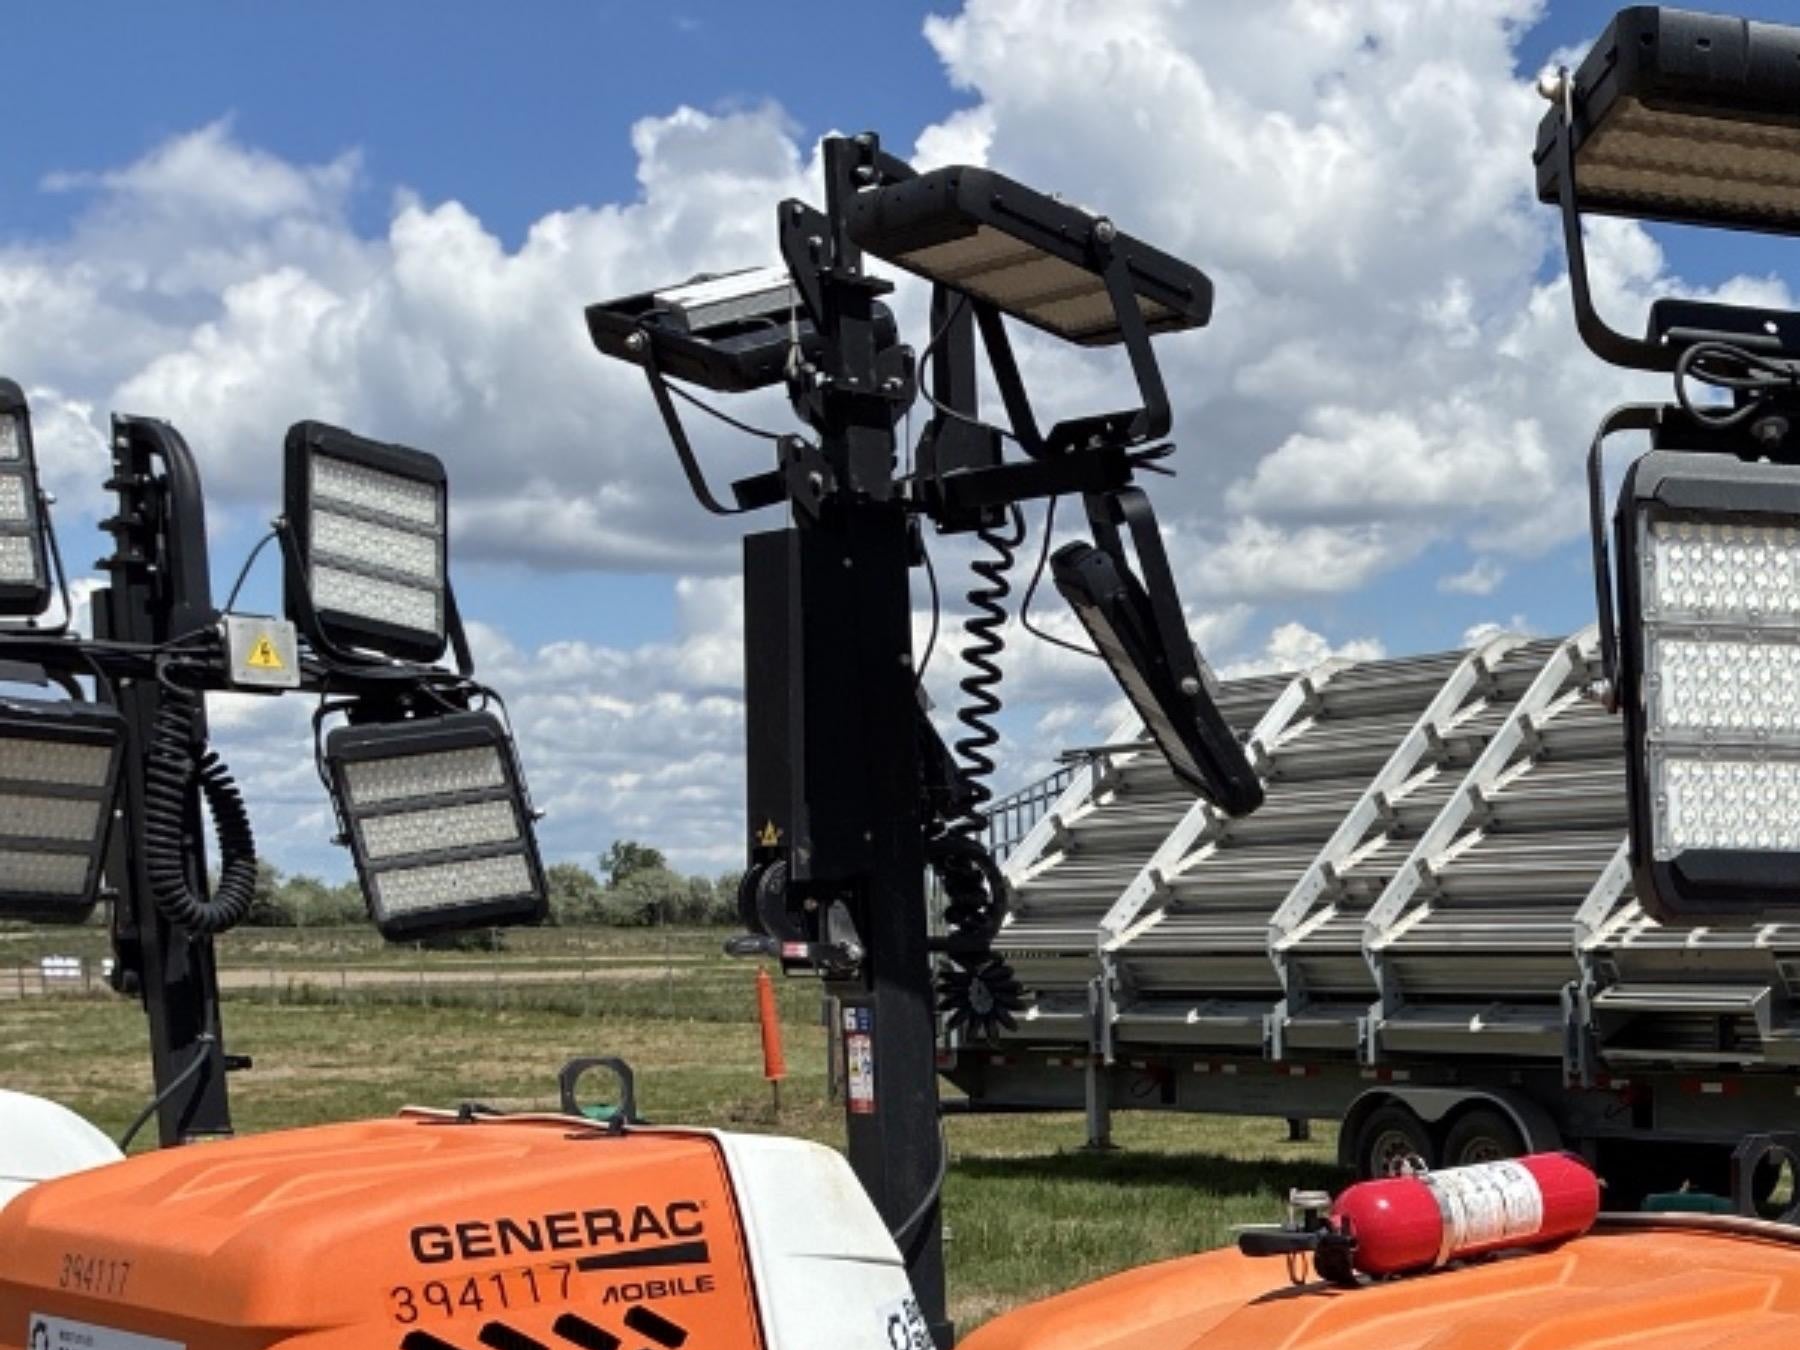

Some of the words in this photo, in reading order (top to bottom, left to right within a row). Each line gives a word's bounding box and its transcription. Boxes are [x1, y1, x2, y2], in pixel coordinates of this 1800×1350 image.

[410, 1200, 703, 1264] GENERAC
[60, 1253, 133, 1296] 394117
[390, 1263, 571, 1325] 394117
